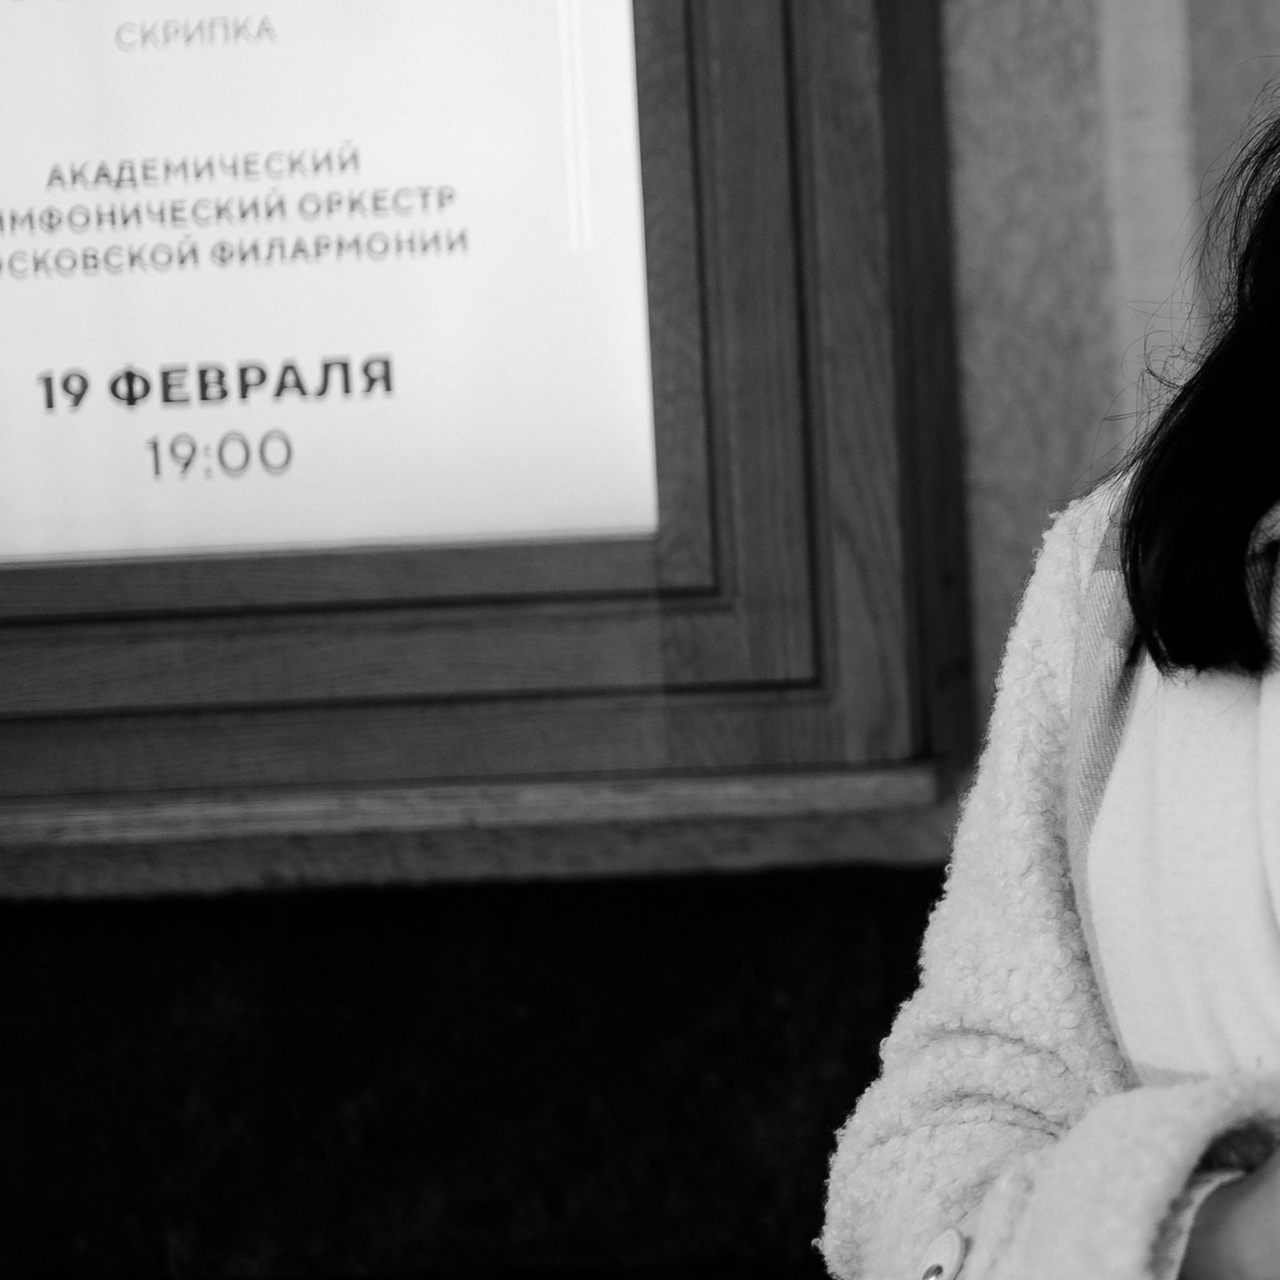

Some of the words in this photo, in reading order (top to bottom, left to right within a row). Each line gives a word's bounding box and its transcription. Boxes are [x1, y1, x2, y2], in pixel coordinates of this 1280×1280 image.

[114, 14, 279, 54] СКРИПКА
[46, 140, 363, 192] АКАДЕМИЧЕСКИЙ
[0, 186, 287, 236] МФОНИЧЕСКИЙ
[297, 185, 457, 222] ОРКЕСТР
[0, 233, 200, 280] СКОВСКОЙ
[209, 228, 469, 270] ФИЛАРМОНИИ
[37, 368, 91, 414] 19
[107, 354, 396, 413] ФЕВРАЛЯ
[145, 429, 296, 481] 19:00
